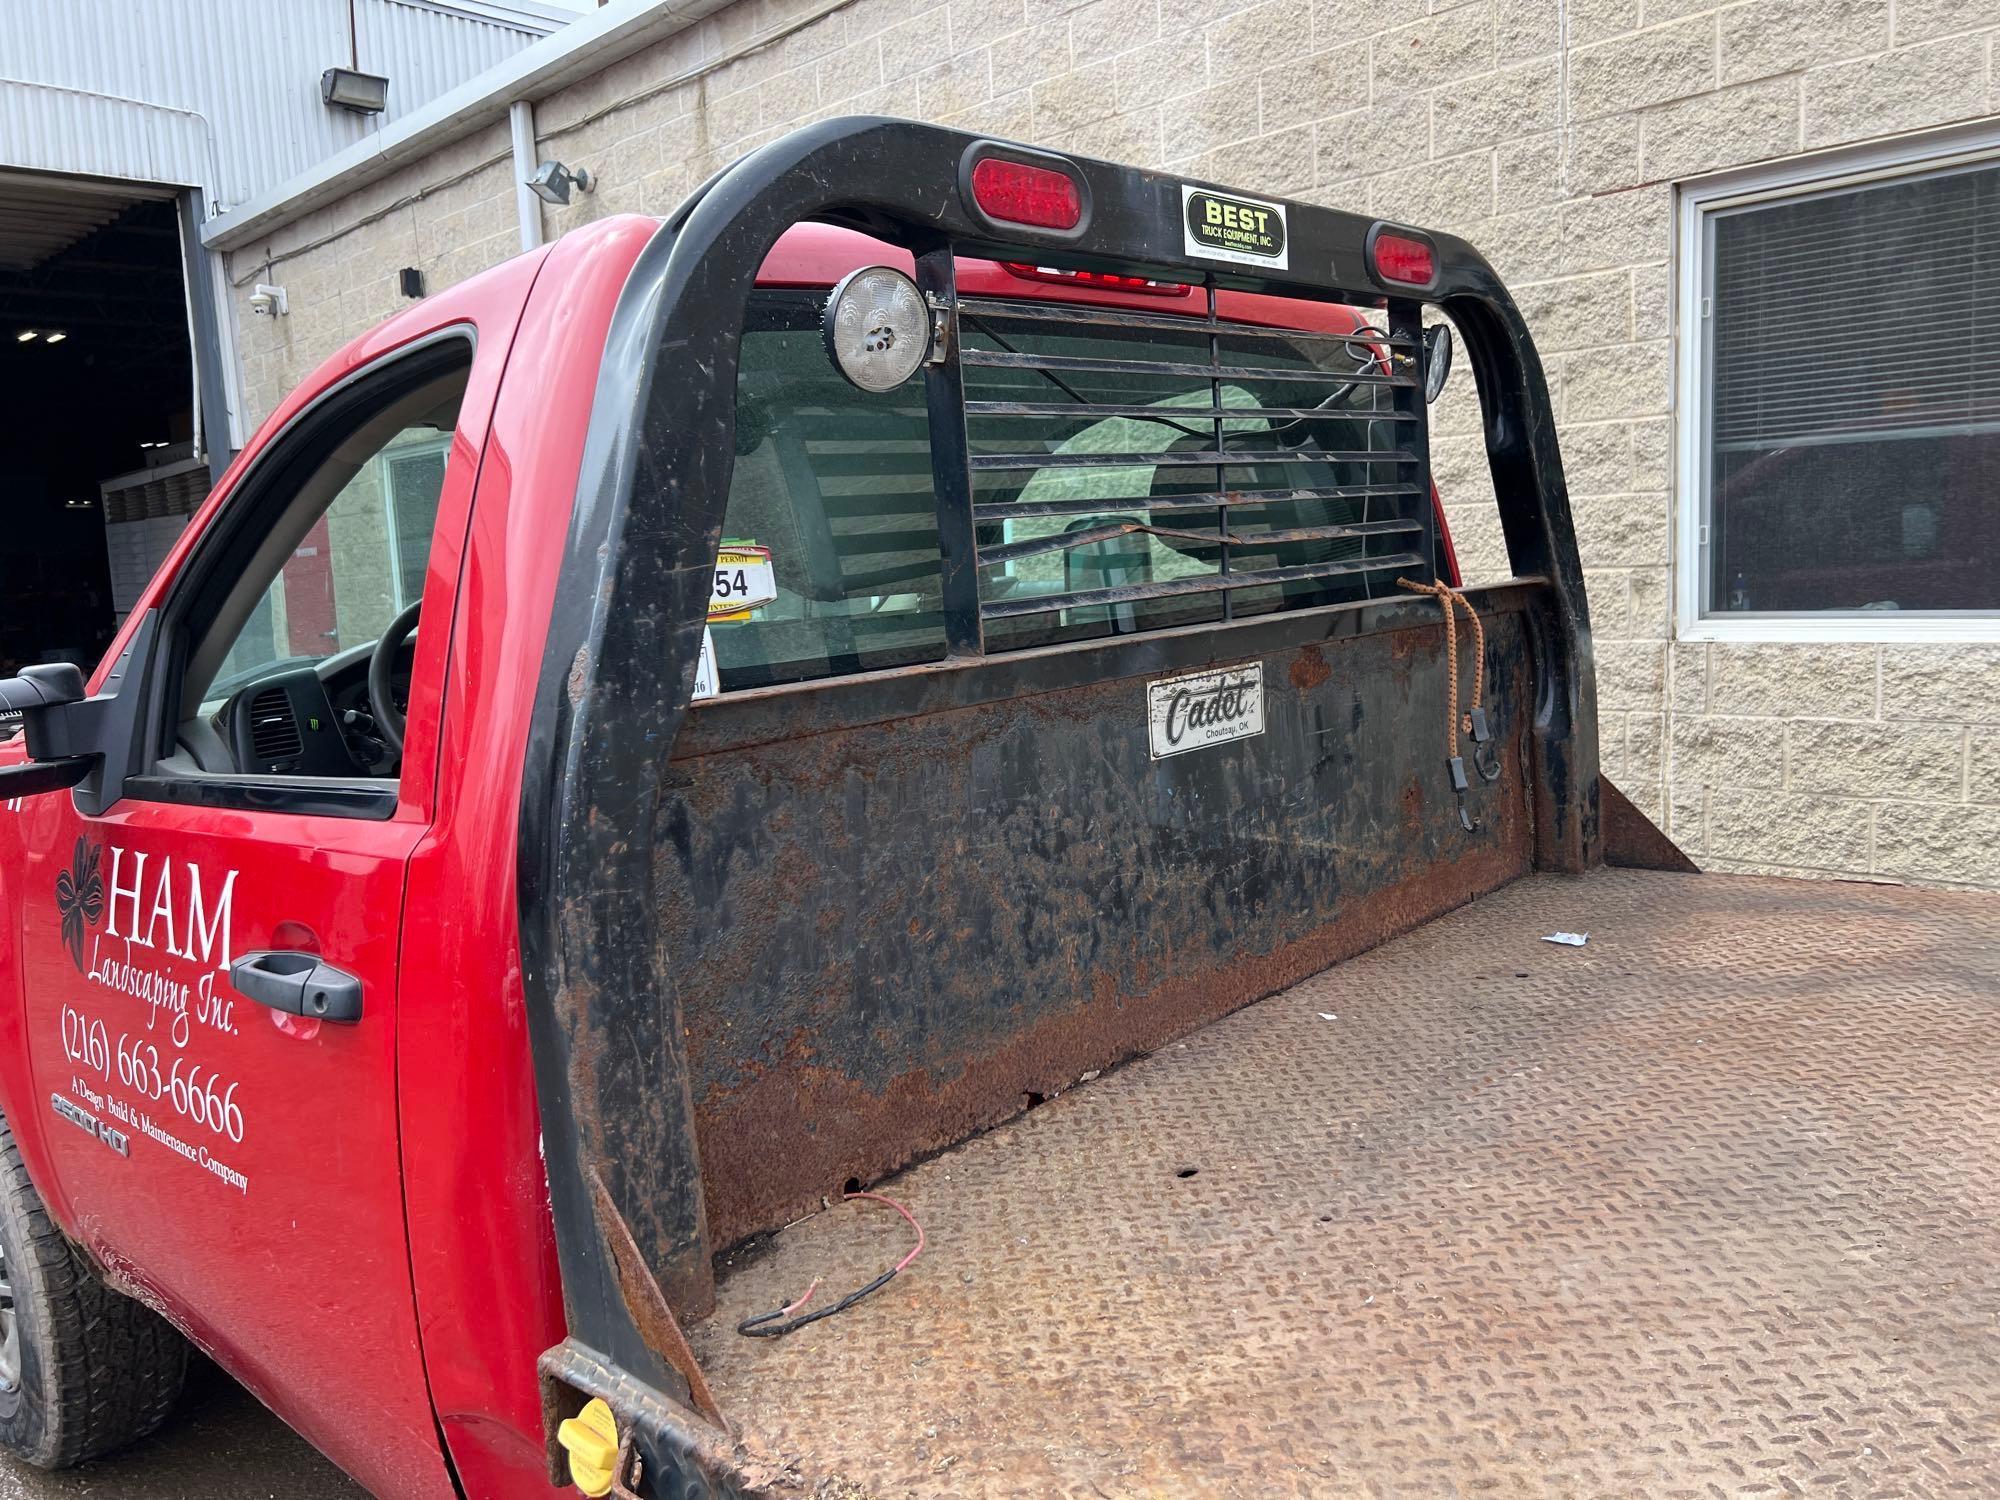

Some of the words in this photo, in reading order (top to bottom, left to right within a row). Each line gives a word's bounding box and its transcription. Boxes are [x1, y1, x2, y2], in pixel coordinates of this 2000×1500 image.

[1205, 199, 1268, 233] BEST
[1201, 224, 1222, 238] TRUCK
[1223, 228, 1259, 246] EQUIPMENT,
[1260, 235, 1273, 247] INC.
[720, 555, 748, 563] PERMIT
[709, 569, 748, 597] 54
[1166, 675, 1257, 746] Cadet
[1238, 720, 1249, 731] OK
[88, 934, 190, 1048] Landscaping
[197, 971, 239, 1036] Inc.
[61, 1003, 110, 1082] (216)
[117, 1033, 244, 1143] 663-6666
[72, 1075, 79, 1094] A
[79, 1078, 104, 1111] Design
[107, 1094, 129, 1123] Build
[130, 1108, 140, 1130] &
[141, 1113, 198, 1162] Maintenance
[198, 1146, 249, 1195] Company
